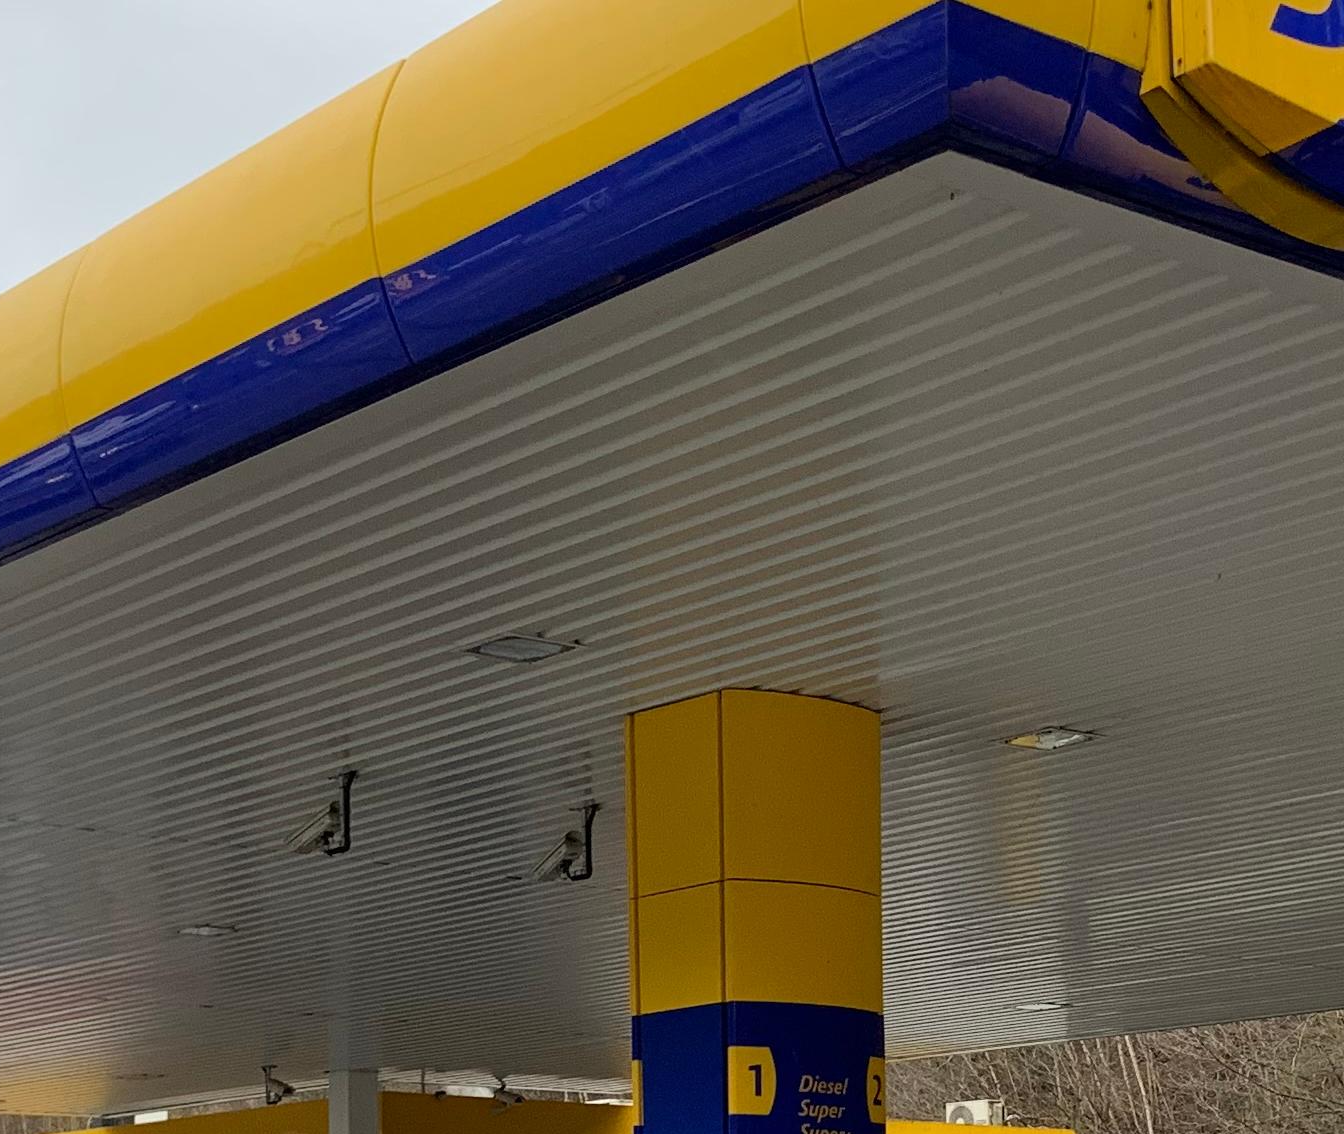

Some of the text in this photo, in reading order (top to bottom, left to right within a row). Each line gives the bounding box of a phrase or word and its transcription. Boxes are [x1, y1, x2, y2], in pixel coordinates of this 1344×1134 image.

[749, 1064, 762, 1096] 1
[798, 1074, 849, 1095] Diesel
[872, 1074, 882, 1106] 2
[797, 1099, 846, 1123] Super
